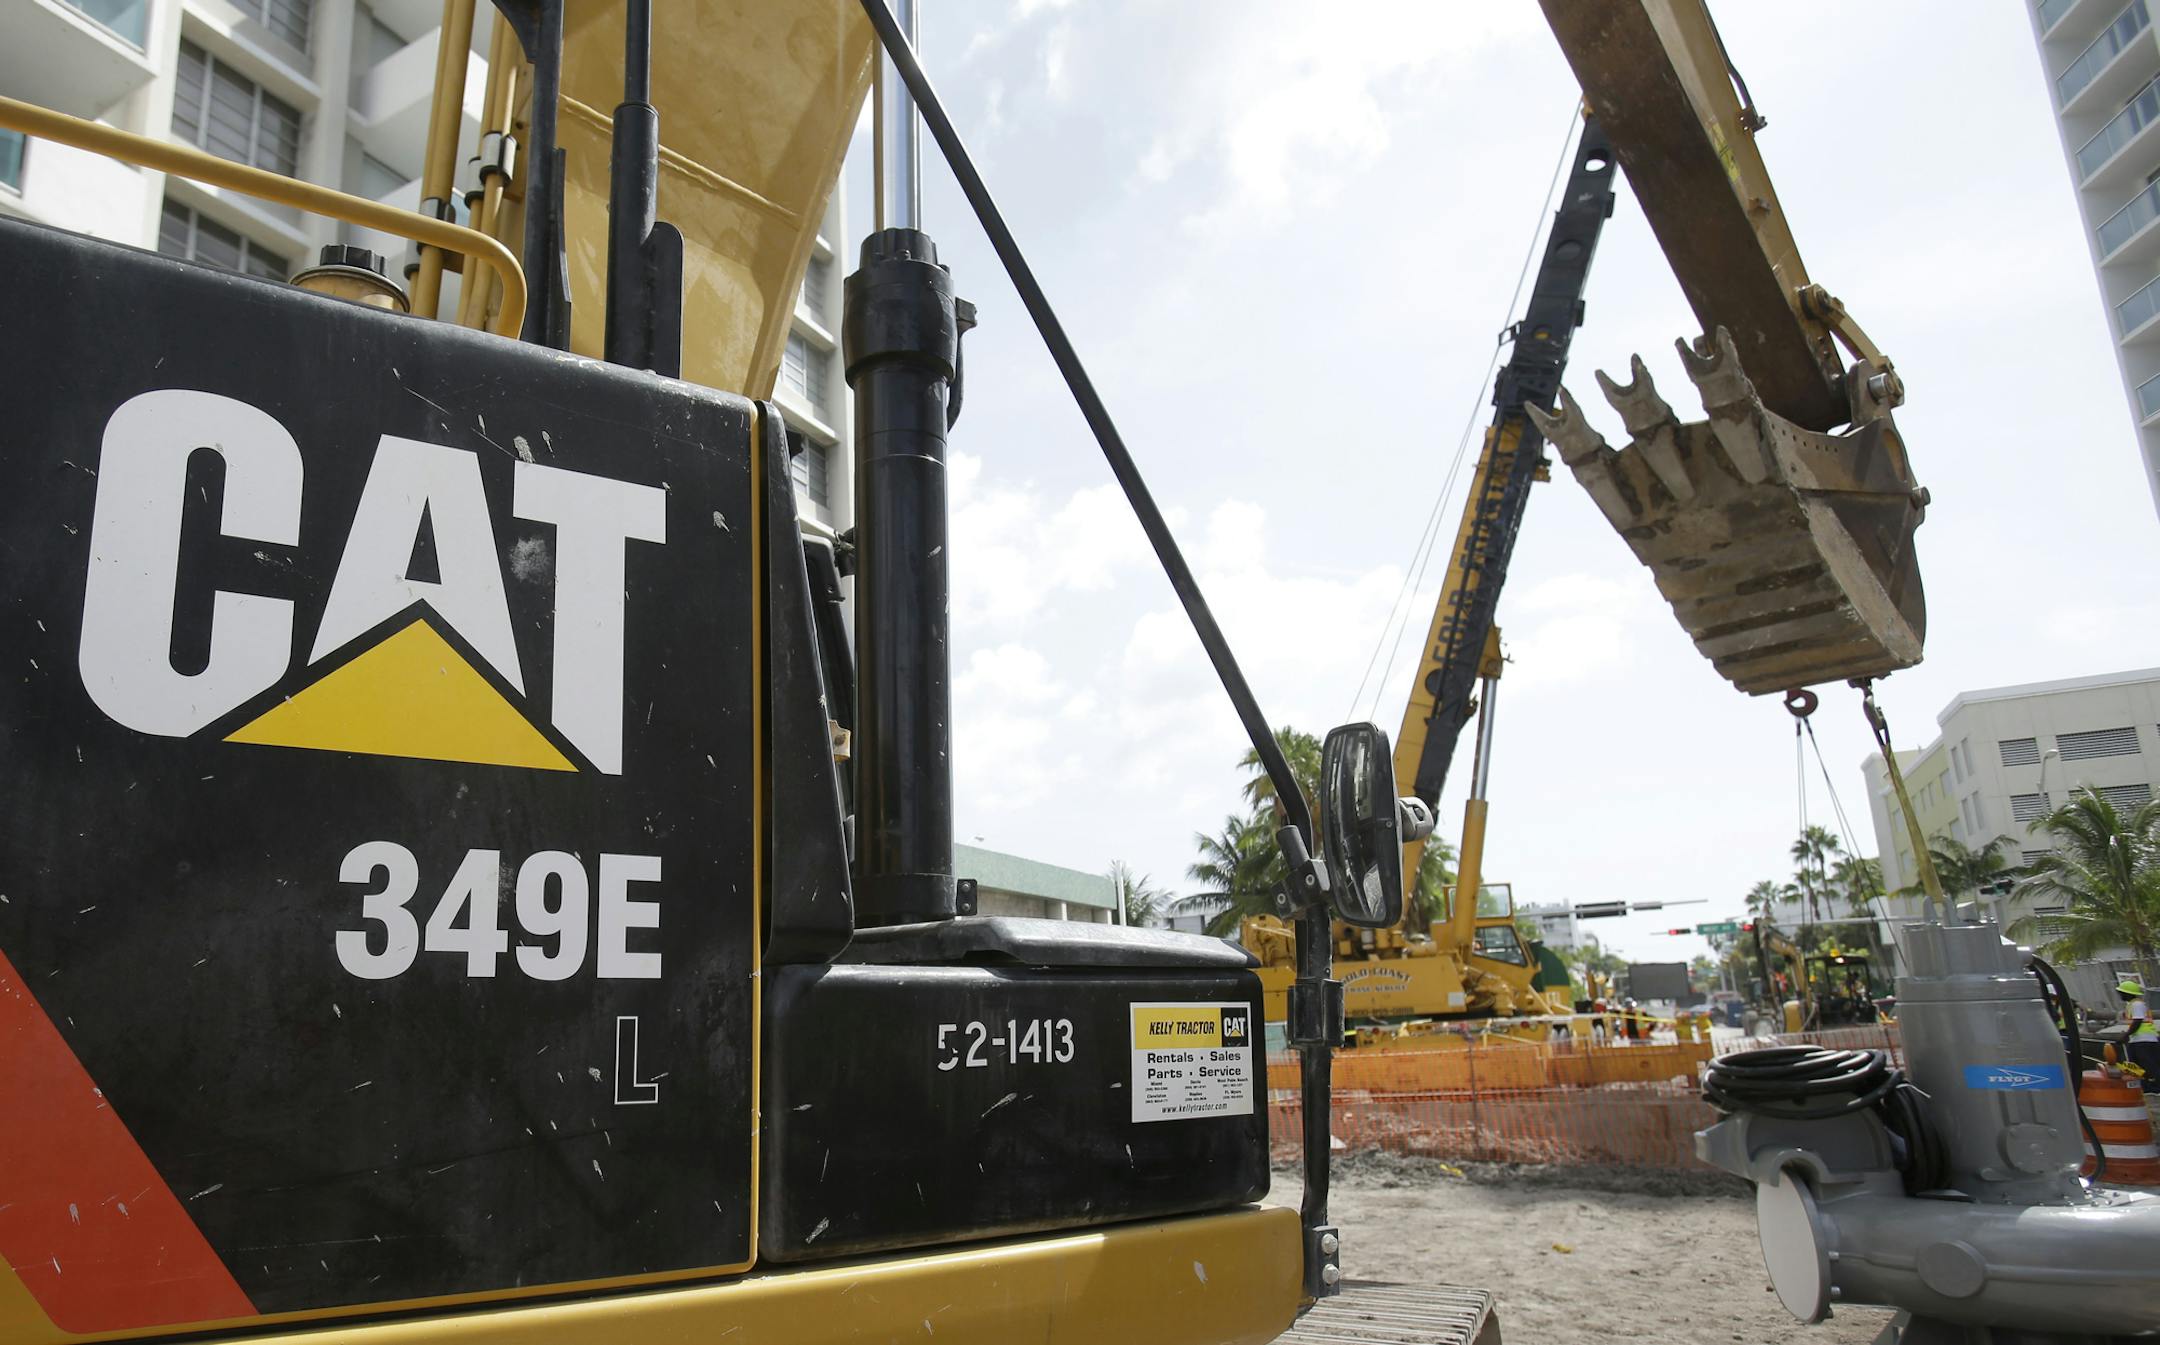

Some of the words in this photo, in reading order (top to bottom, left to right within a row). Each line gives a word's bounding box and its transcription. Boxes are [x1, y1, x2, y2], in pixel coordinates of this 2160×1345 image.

[79, 388, 667, 775] CAT
[335, 840, 662, 981] 349E
[1149, 1021, 1174, 1035] KELLY
[1176, 1020, 1215, 1035] TRACTOR
[1223, 1017, 1246, 1037] CAT
[937, 1018, 1075, 1071] 52-1413
[614, 1015, 658, 1104] L
[1147, 1052, 1194, 1063] Rentals
[1210, 1051, 1241, 1062] Sales
[1148, 1068, 1183, 1079] Parts
[1199, 1066, 1241, 1077] Service
[1987, 1075, 2032, 1083] FLYGT
[1162, 1103, 1228, 1113] www.kellytractor.com
